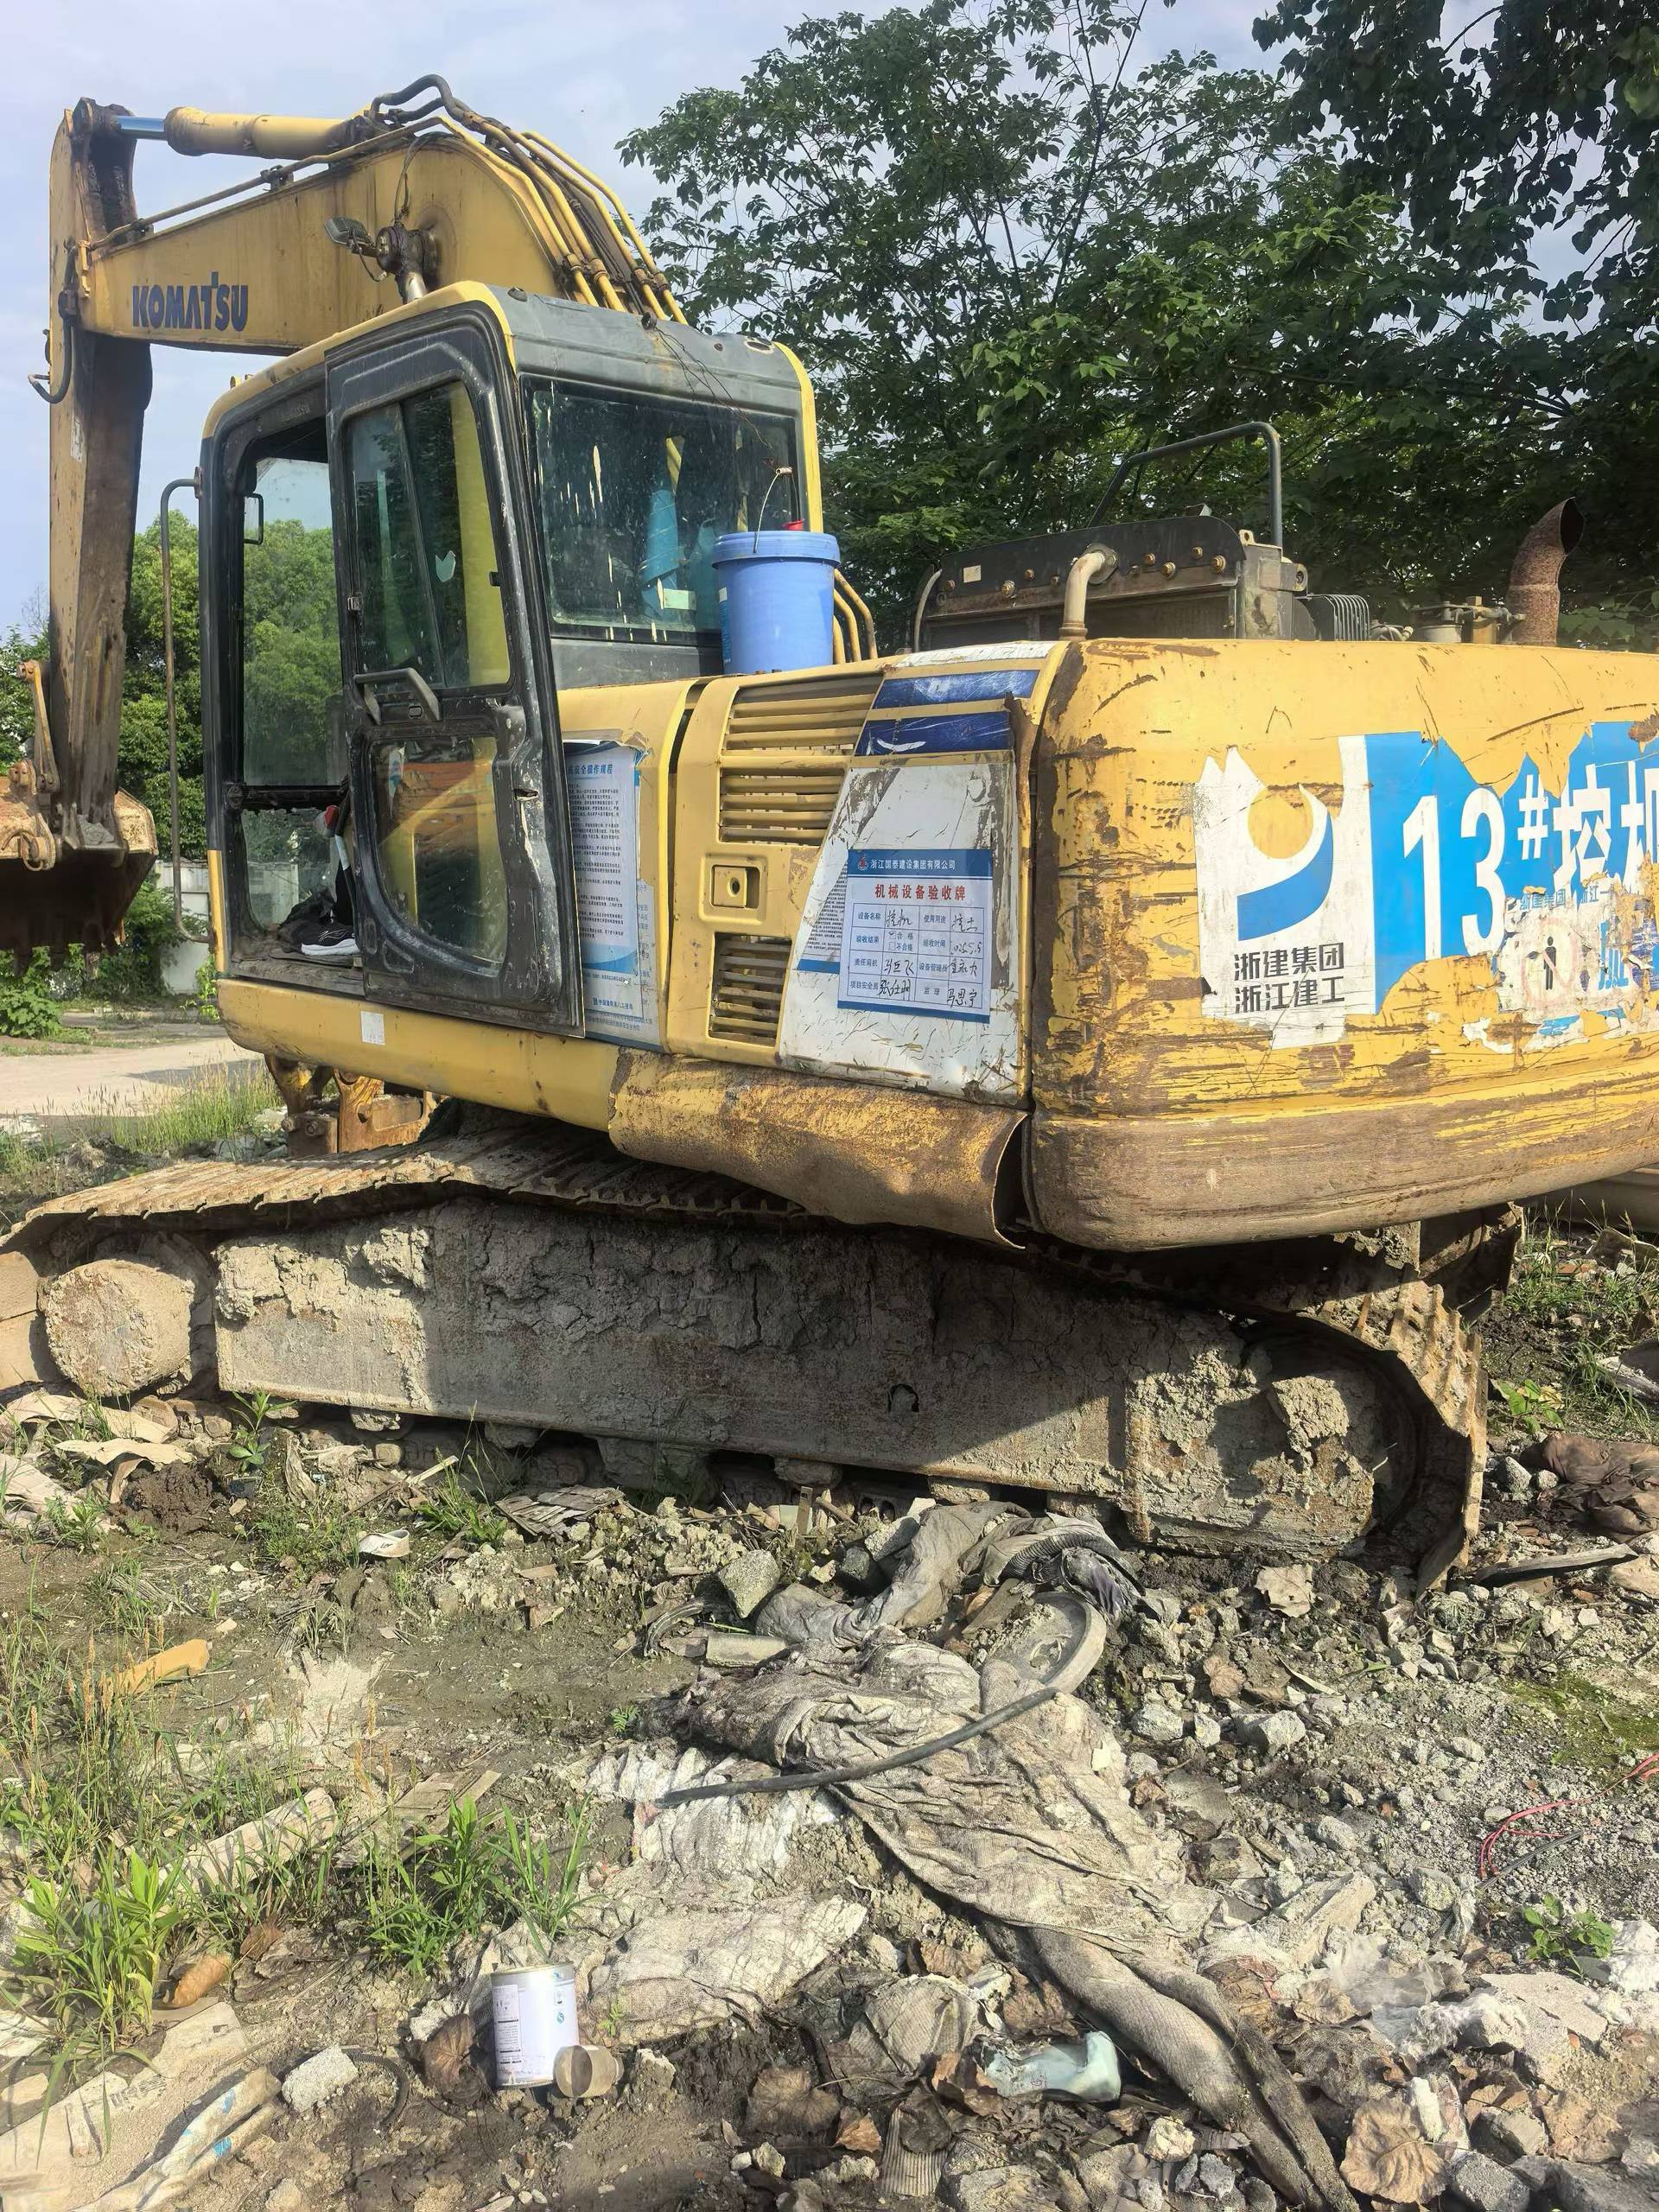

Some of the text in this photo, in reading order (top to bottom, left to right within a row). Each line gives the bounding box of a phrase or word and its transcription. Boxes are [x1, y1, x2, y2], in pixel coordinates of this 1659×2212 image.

[132, 271, 249, 332] KOMATSU
[870, 859, 956, 870] 浙江国泰建设集团有限公司
[874, 884, 966, 901] 机械设备验收牌
[858, 911, 881, 921] 设备名称
[924, 914, 946, 924] 使用用途
[855, 935, 879, 944] 验收结果
[923, 938, 946, 948] 验收时间
[896, 943, 913, 951] 不合格
[855, 957, 878, 967] 责任司机
[1234, 942, 1344, 982] 浙建集团
[918, 963, 947, 973] 设备管理员
[850, 981, 879, 990] 项目安全员
[1234, 976, 1345, 1014] 浙江建工
